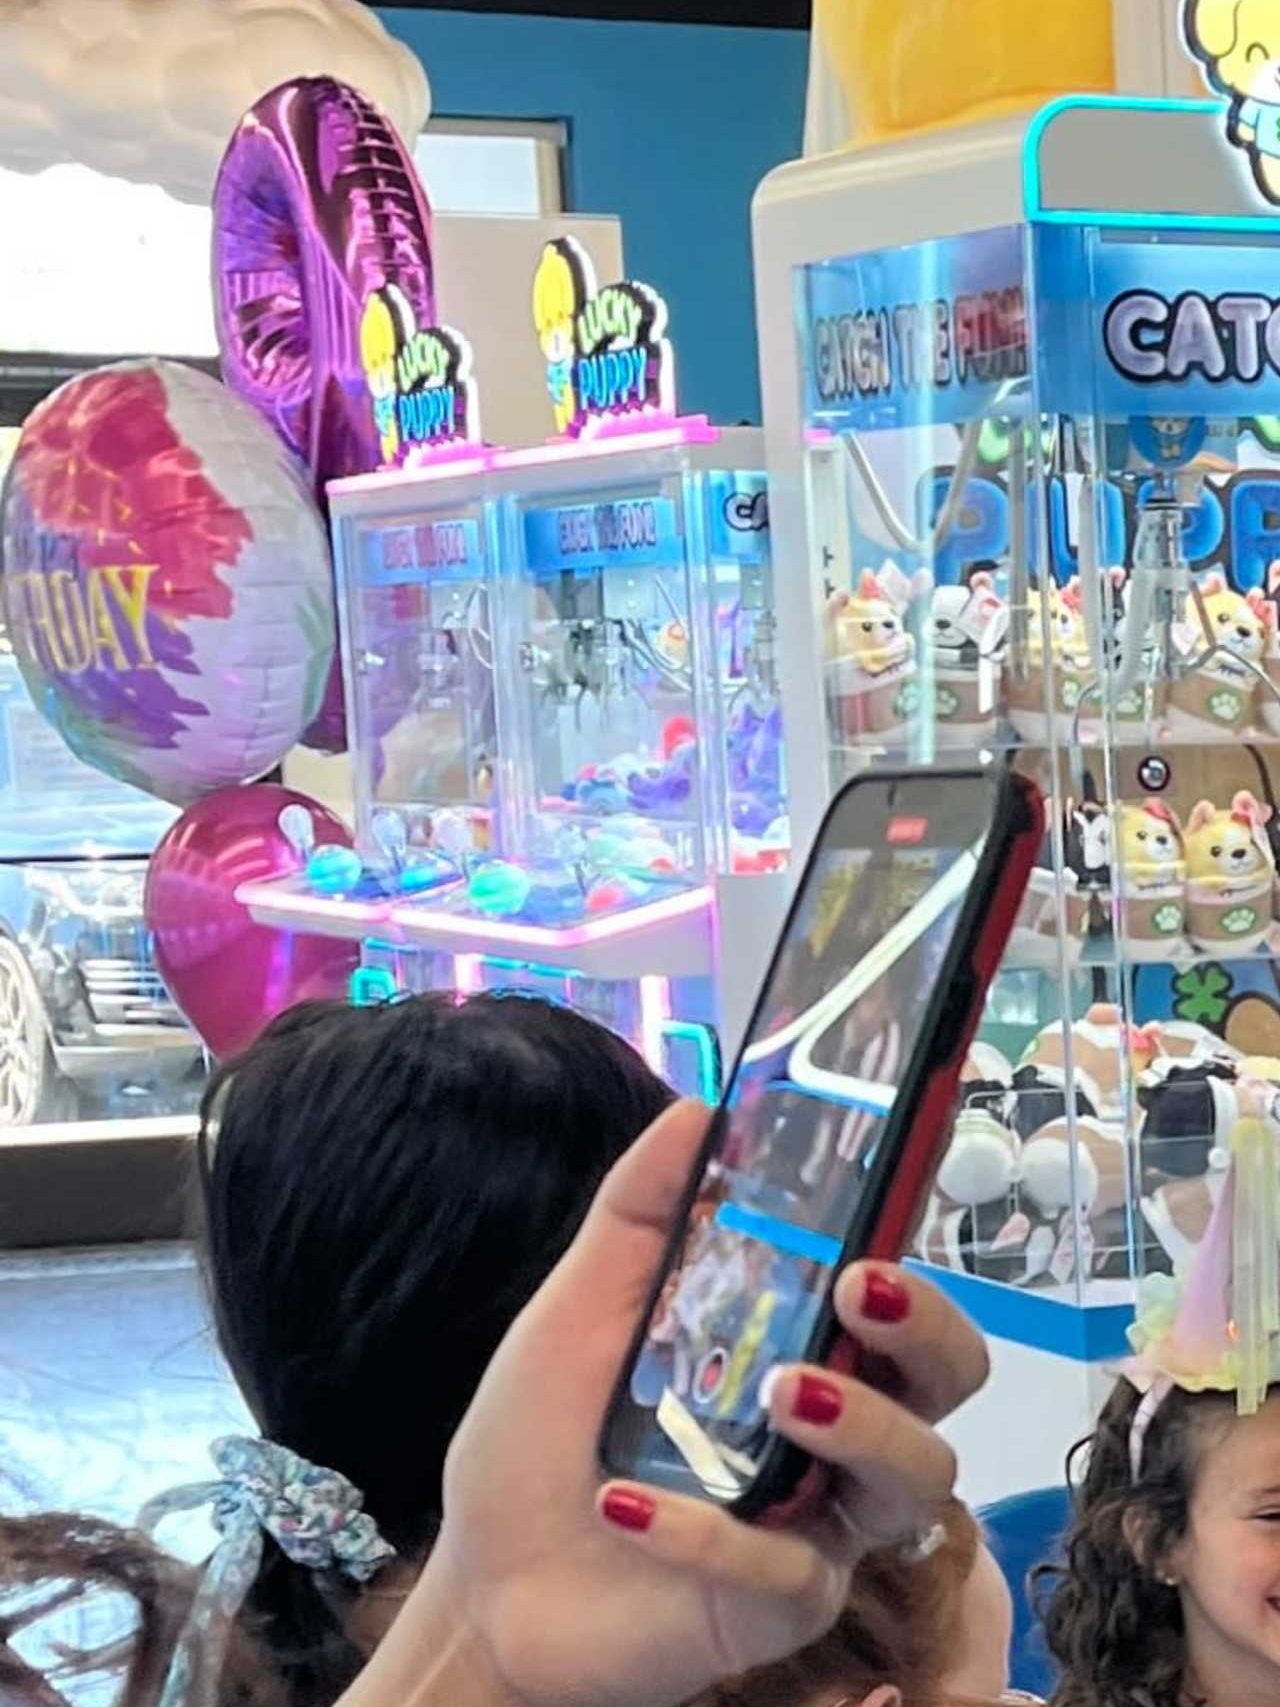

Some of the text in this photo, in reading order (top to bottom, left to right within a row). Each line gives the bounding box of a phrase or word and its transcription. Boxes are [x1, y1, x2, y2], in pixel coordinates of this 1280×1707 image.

[578, 287, 644, 355] LUCKY
[398, 331, 452, 393] LUCKY
[577, 346, 648, 410] PUPPY
[399, 383, 456, 443] PUPPY
